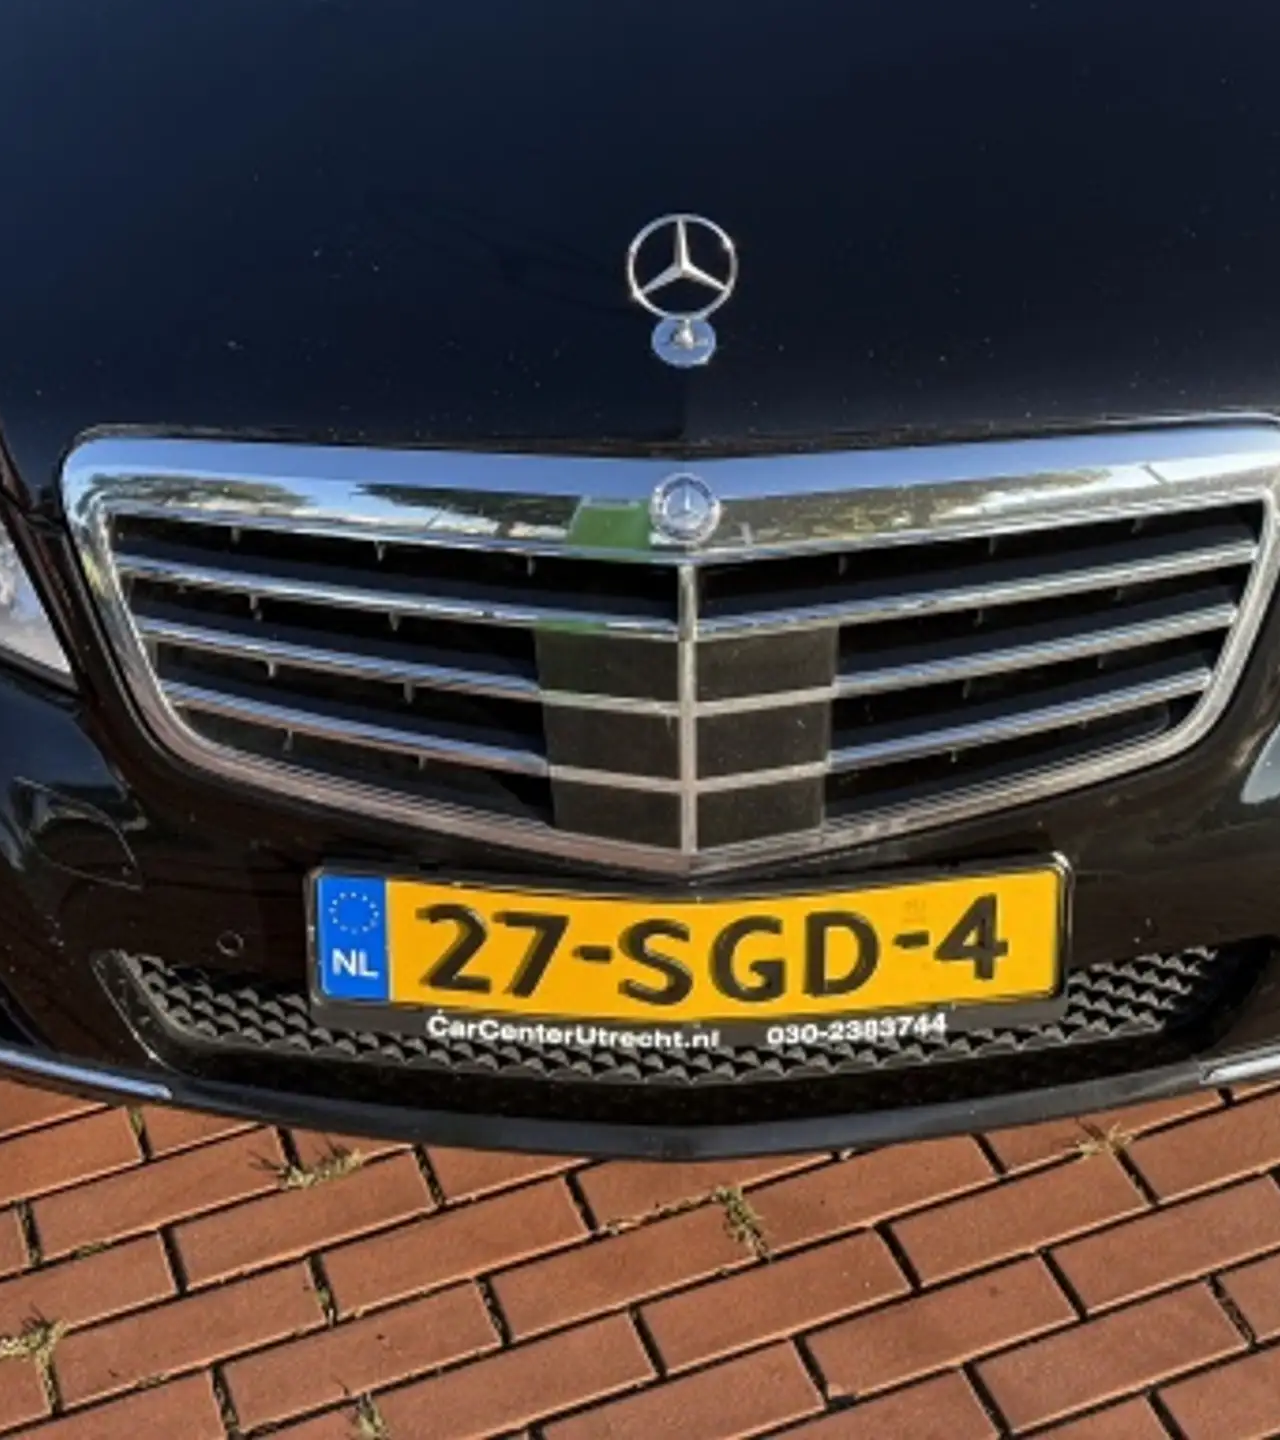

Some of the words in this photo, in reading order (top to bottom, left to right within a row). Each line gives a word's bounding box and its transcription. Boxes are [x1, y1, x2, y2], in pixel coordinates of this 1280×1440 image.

[331, 947, 379, 978] NL
[415, 893, 1009, 1007] 27-SGD-4
[426, 1014, 720, 1048] CarCenterUtrecht.nl
